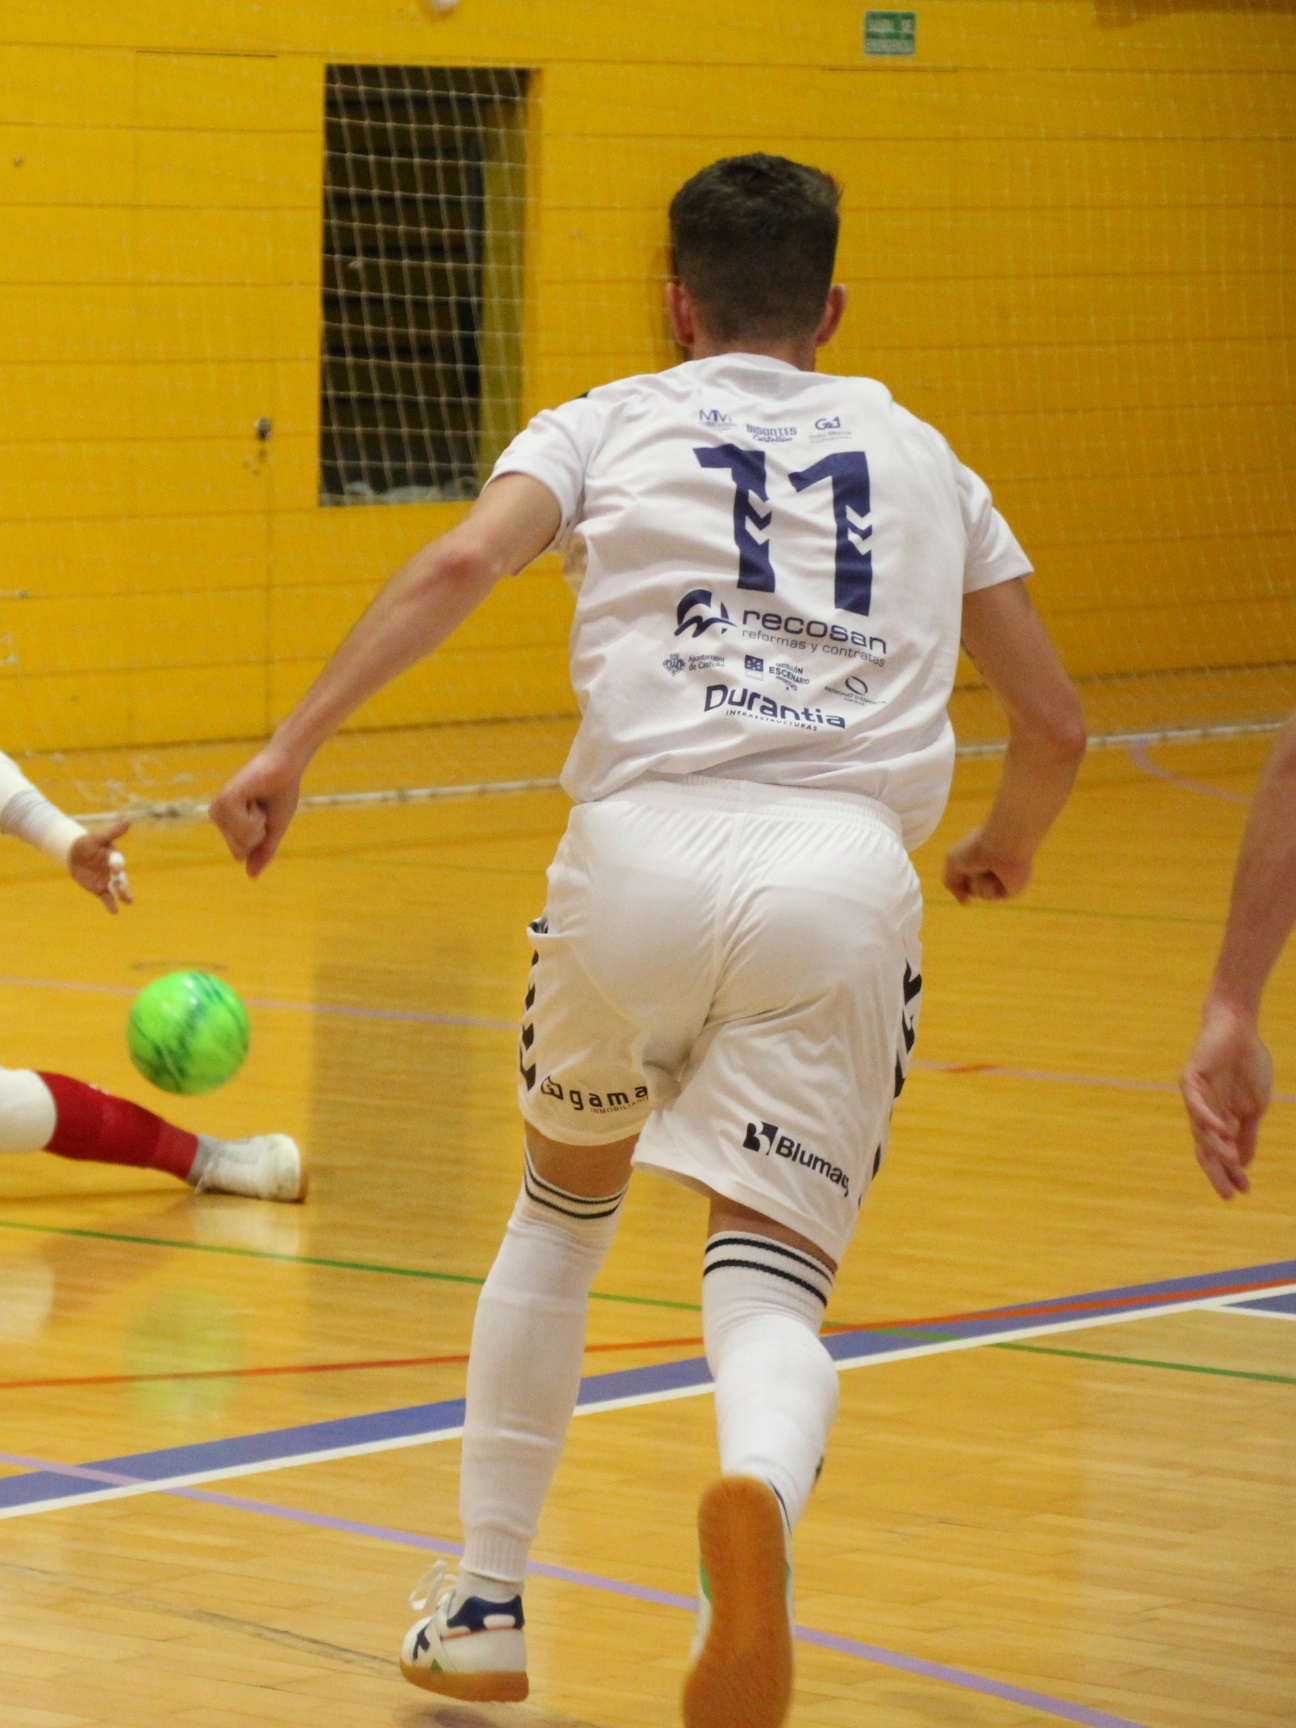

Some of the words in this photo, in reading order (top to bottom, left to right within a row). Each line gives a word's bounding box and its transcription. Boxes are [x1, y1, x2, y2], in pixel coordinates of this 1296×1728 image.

[692, 443, 873, 617] 11
[742, 609, 887, 655] recosan
[742, 629, 806, 650] reformas
[811, 642, 819, 654] y
[822, 644, 886, 668] contratas
[769, 666, 810, 685] ESCENARIO
[704, 684, 846, 729] Durantia
[725, 710, 818, 732] INFRAESTRUCTURAS
[569, 1084, 649, 1111] gama
[590, 1095, 649, 1114] INMOBILIARI
